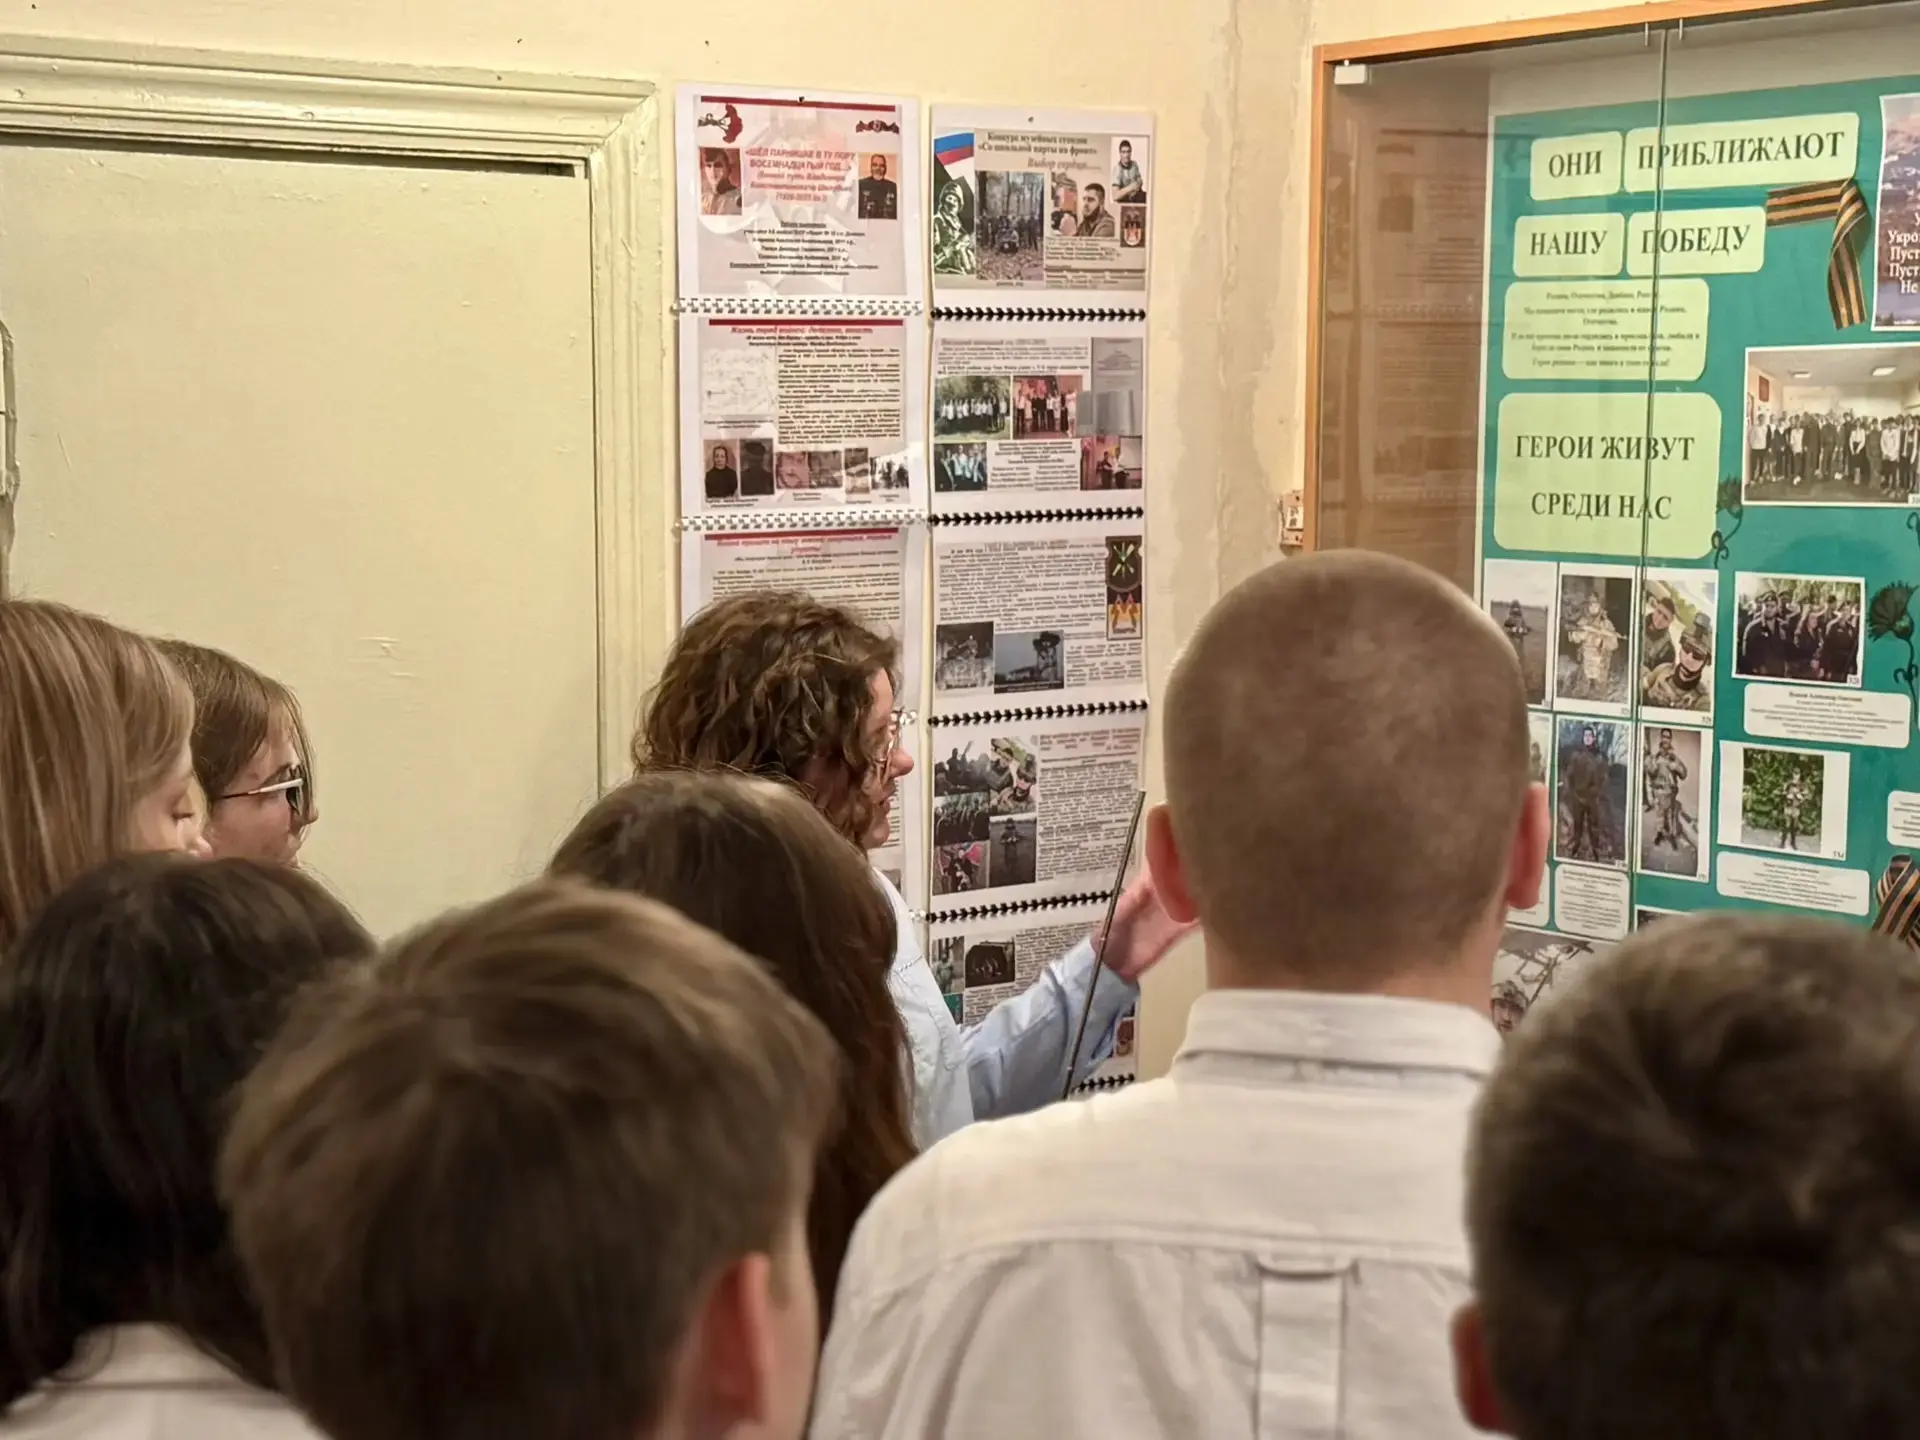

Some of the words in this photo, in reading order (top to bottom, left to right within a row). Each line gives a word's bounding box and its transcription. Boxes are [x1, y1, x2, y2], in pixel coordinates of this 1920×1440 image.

[1548, 150, 1602, 178] ОНИ
[1638, 131, 1845, 170] ПРИБЛИЖАЮТ
[1530, 230, 1608, 256] НАШУ
[1641, 223, 1751, 257] ПОБЕДУ
[1888, 229, 1920, 247] Укро
[1515, 435, 1594, 459] ГЕРОИ
[1600, 436, 1695, 461] ЖИВУТ
[1531, 492, 1611, 521] СРЕДИ
[1618, 494, 1672, 520] НАС
